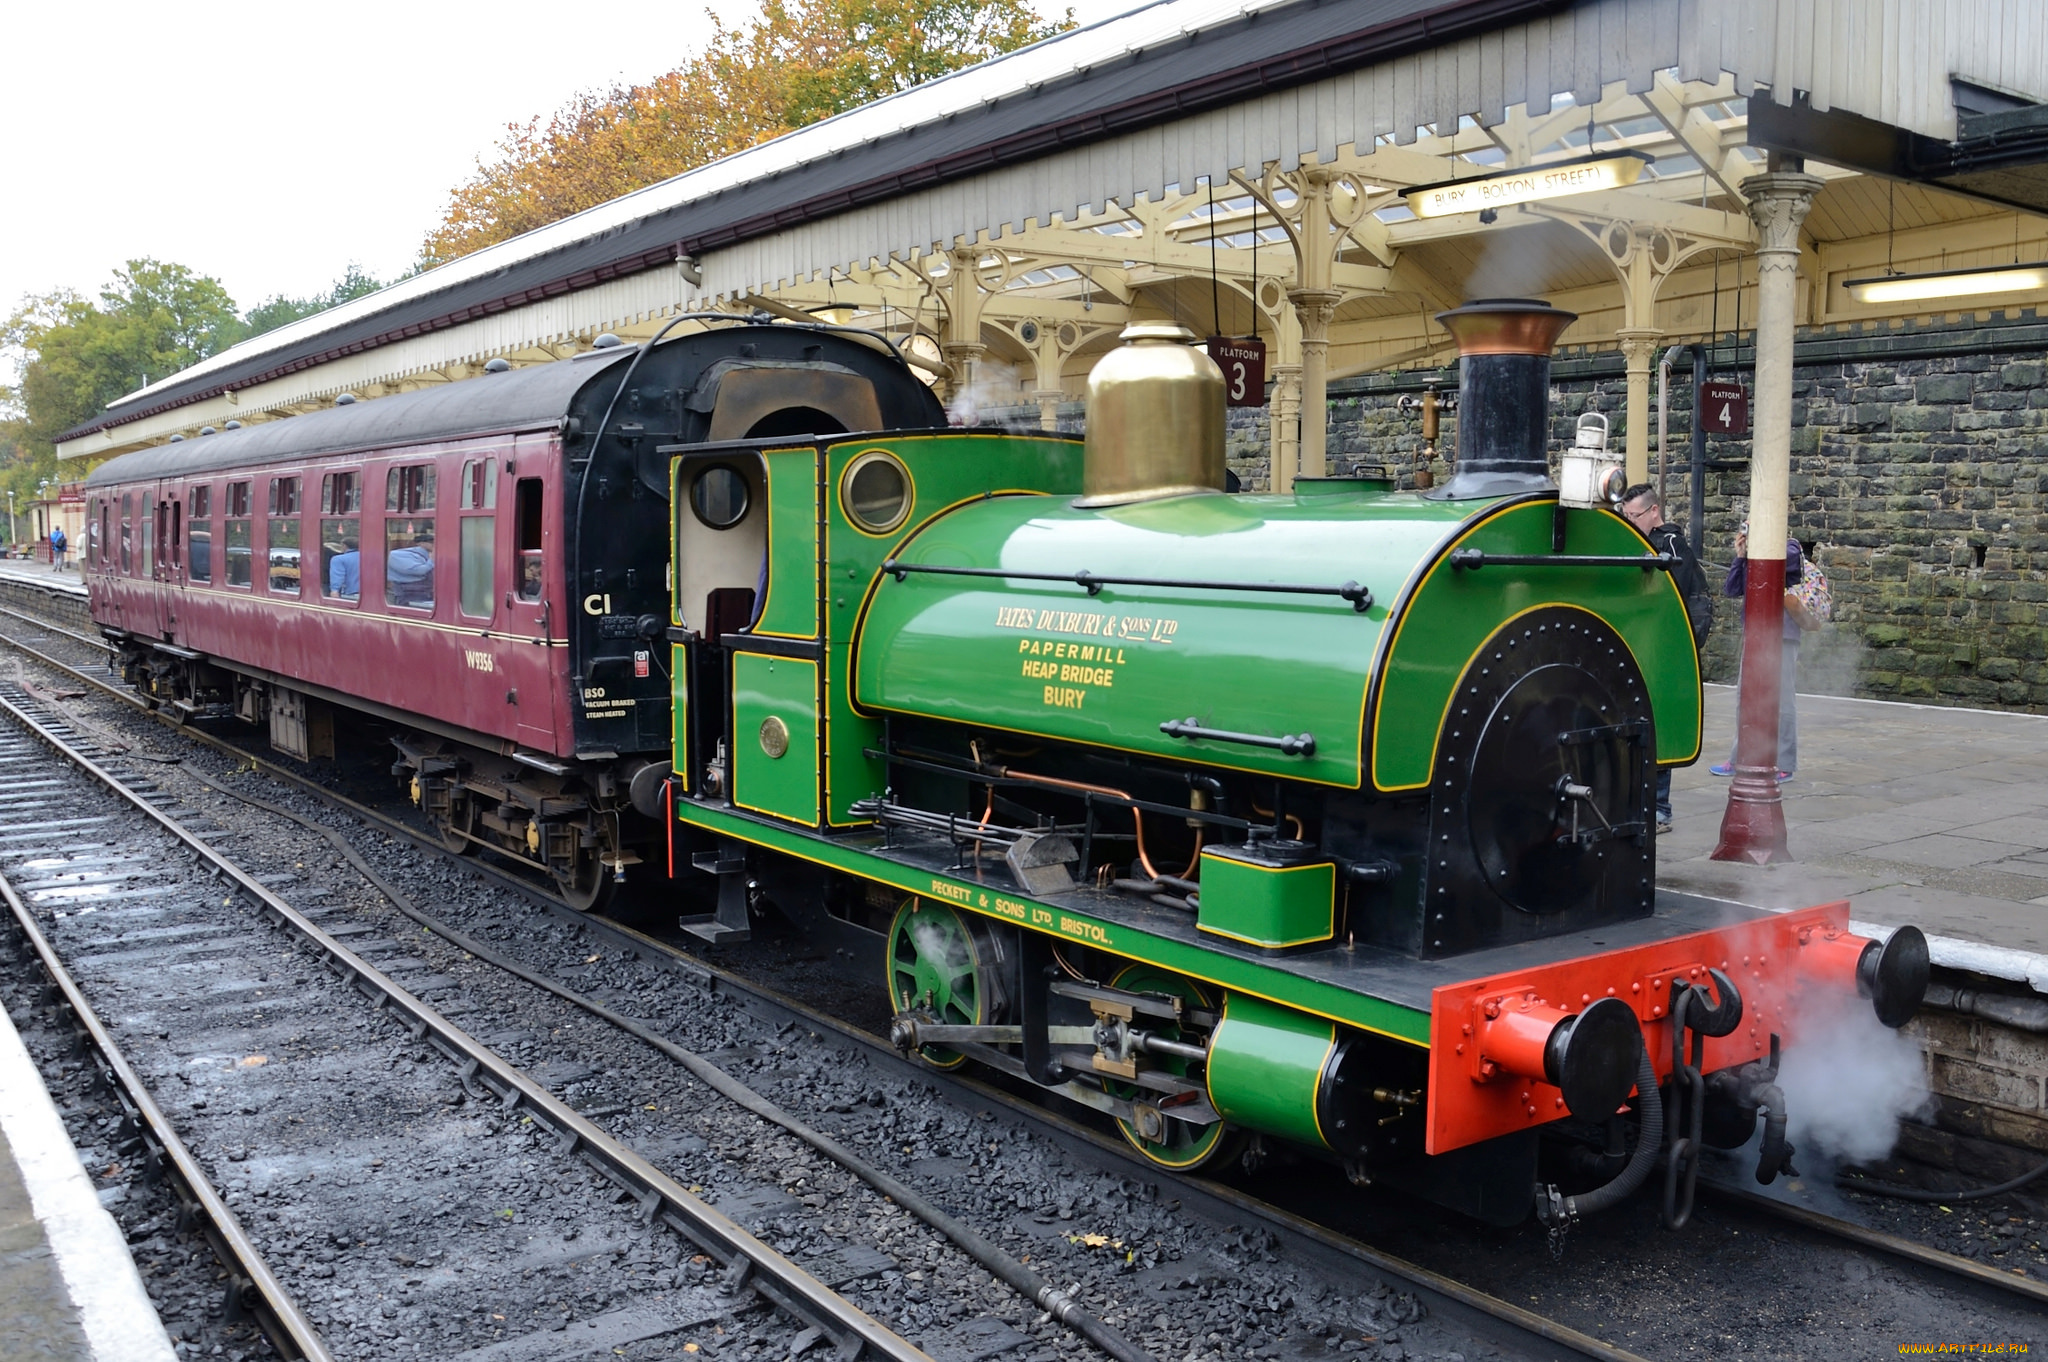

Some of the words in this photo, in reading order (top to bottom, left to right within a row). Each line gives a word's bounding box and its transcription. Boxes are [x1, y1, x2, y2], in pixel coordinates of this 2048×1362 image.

[1434, 189, 1465, 208] BURY
[1478, 177, 1536, 201] (BOLTON
[1544, 165, 1602, 190] STREET)
[1220, 346, 1260, 360] PLATFORM
[1231, 362, 1246, 401] 3
[1711, 390, 1741, 400] PLATFORM
[1719, 402, 1731, 428] 4
[995, 606, 1036, 630] YATES
[1036, 609, 1105, 636] DUXBURY
[1102, 615, 1117, 637] &
[1118, 616, 1153, 641] SONS
[1151, 619, 1178, 644] LTD
[1019, 639, 1126, 664] PAPERMILL
[1022, 660, 1058, 680] HEAP
[1060, 664, 1114, 687] BRIDGE
[584, 687, 606, 699] BSO
[585, 700, 610, 708] VACUUM
[611, 699, 636, 707] BRAKED
[1043, 685, 1086, 709] BURY
[604, 710, 626, 718] HEATED
[931, 879, 972, 902] PECKETT
[978, 893, 989, 908] &
[995, 898, 1025, 919] SONS
[1060, 916, 1113, 945] BRISTOL.
